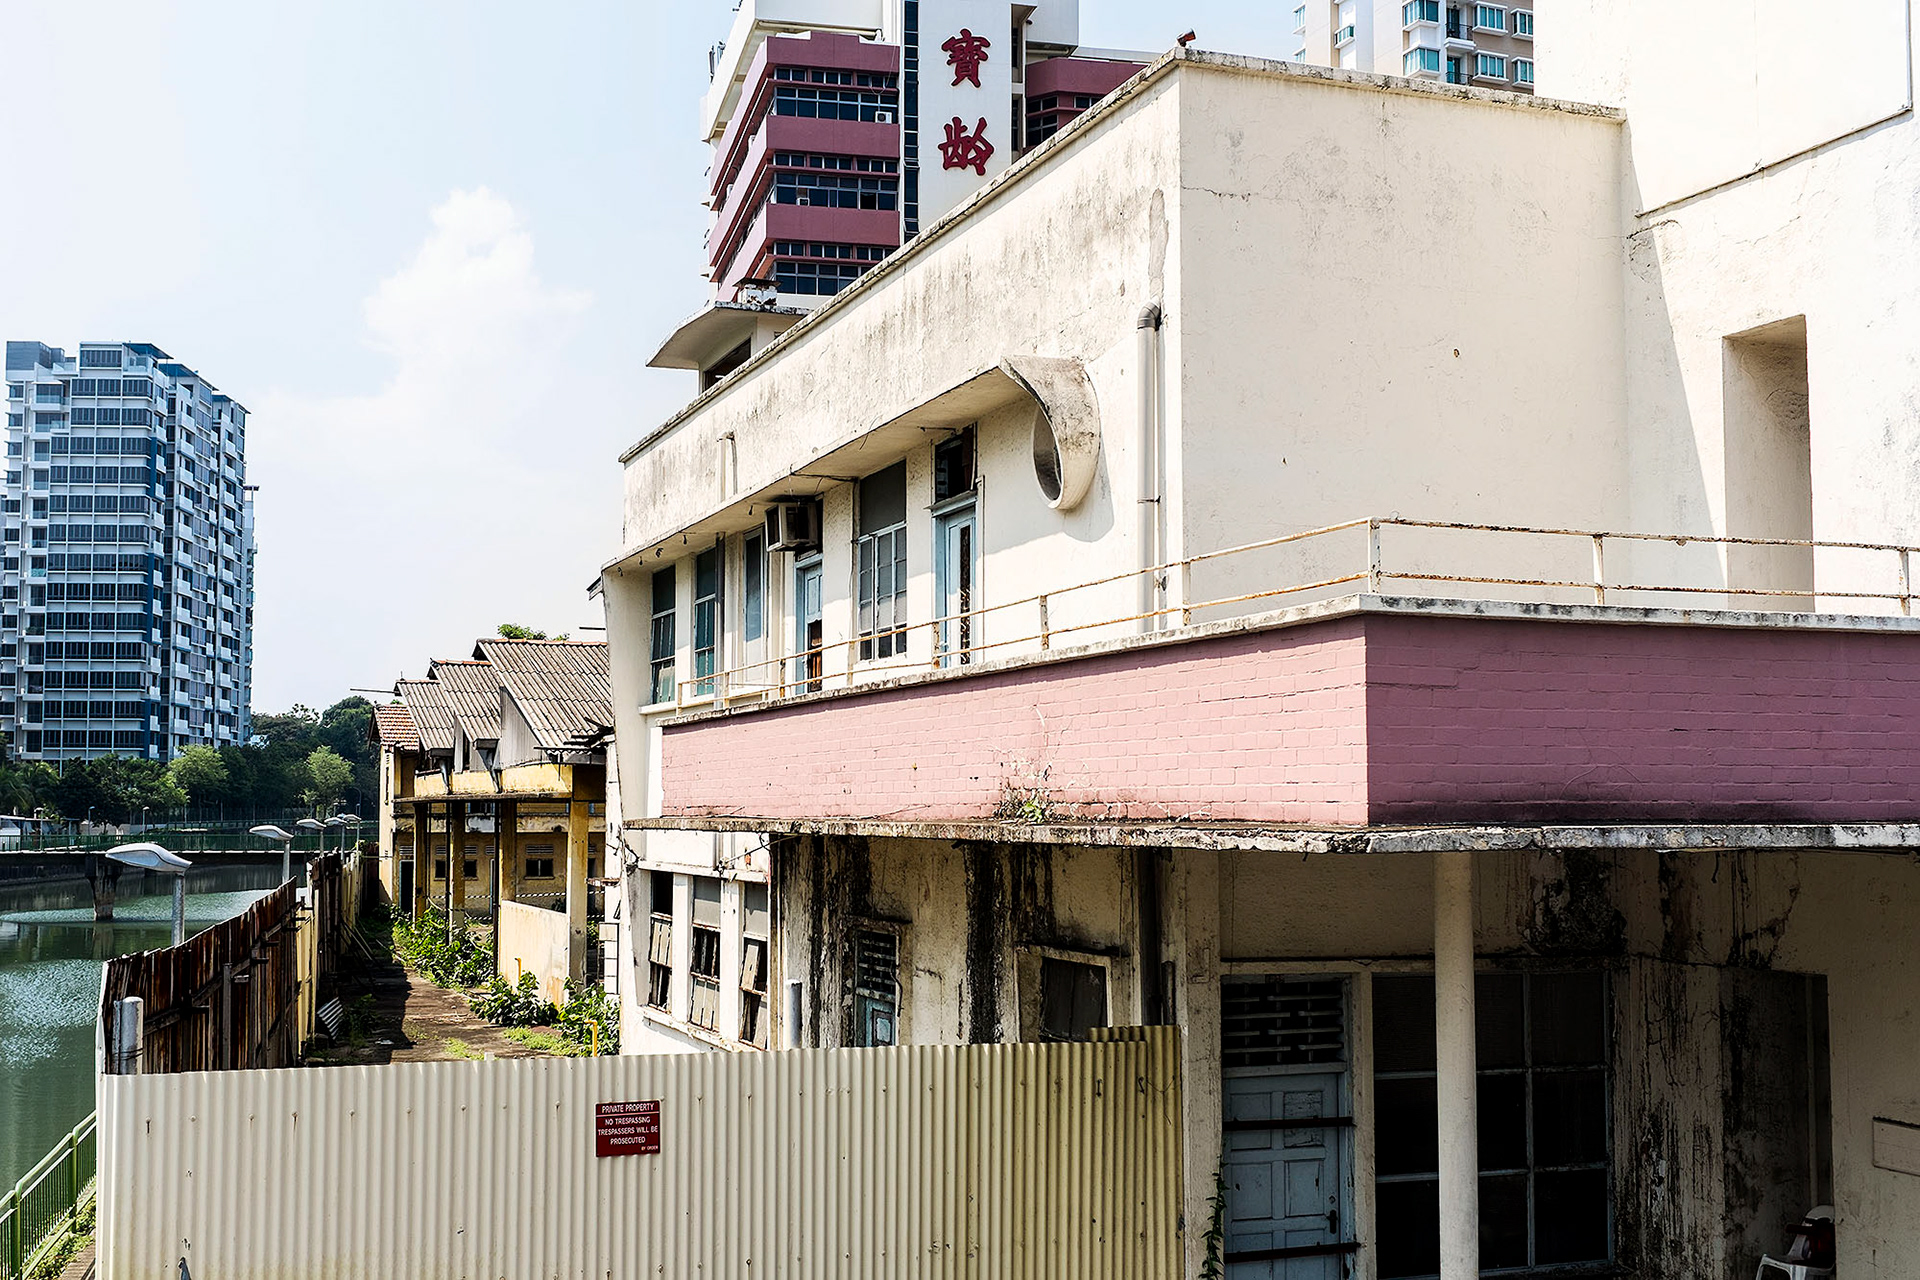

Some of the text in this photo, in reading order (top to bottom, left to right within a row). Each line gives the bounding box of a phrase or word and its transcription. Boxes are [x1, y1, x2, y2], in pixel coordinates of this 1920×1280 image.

[601, 1103, 654, 1113] PRIVATE PROPERTY
[615, 1116, 651, 1124] TRESPASSING
[598, 1127, 635, 1135] TRESPASSERS
[610, 1136, 646, 1145] PROSECUTED
